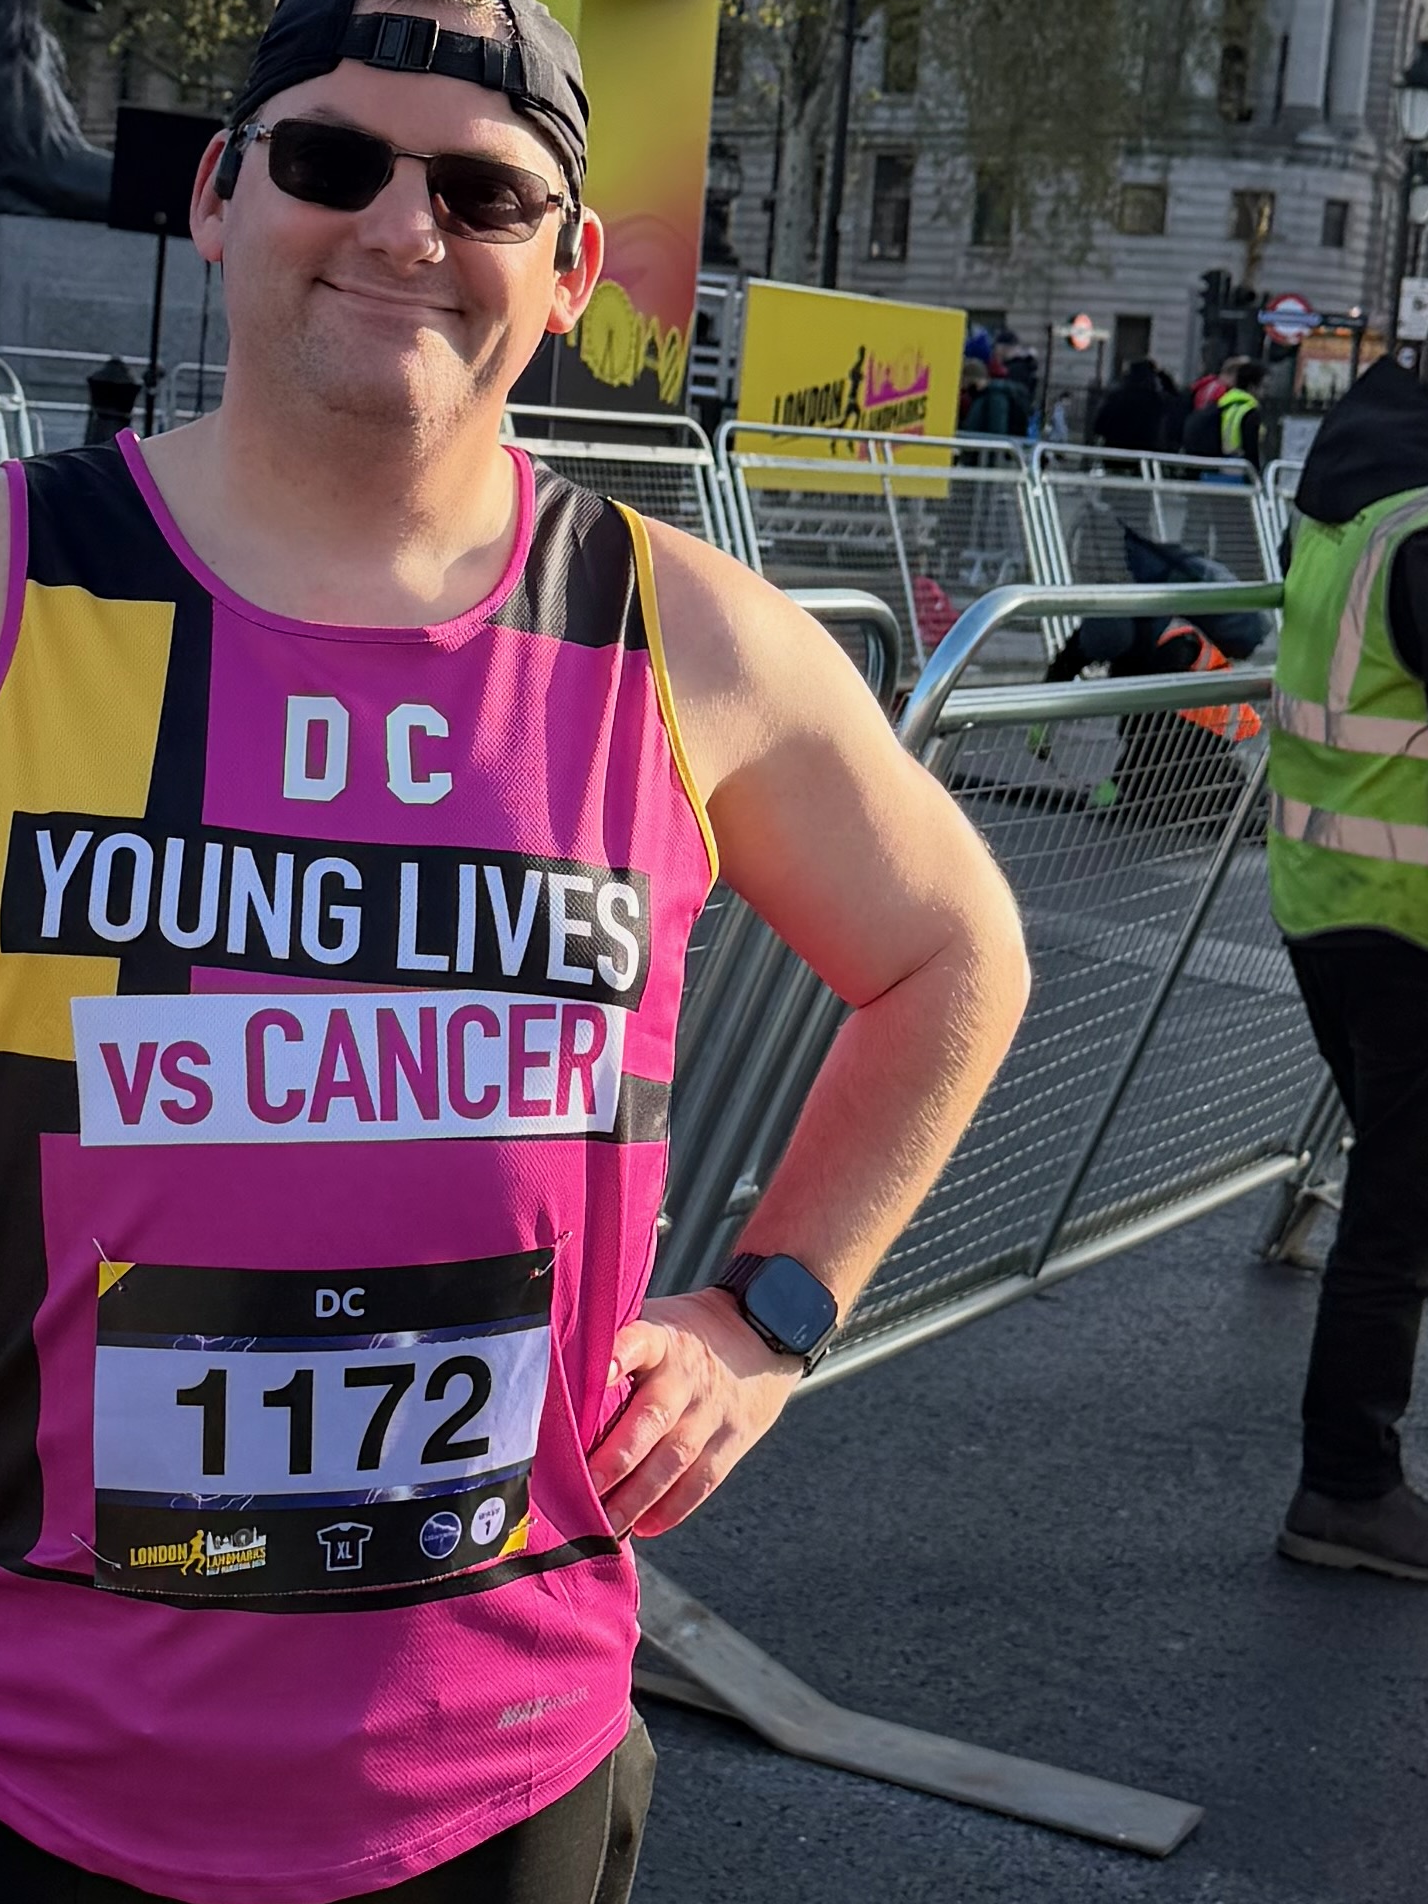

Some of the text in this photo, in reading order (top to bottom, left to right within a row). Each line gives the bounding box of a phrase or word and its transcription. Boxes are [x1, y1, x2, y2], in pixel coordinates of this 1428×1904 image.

[35, 829, 640, 992] YOUNG LIVES
[244, 1003, 608, 1123] CANCER
[315, 1287, 365, 1318] DC
[176, 1355, 492, 1476] 1172
[130, 1542, 188, 1567] LONDON
[337, 1541, 353, 1559] XL
